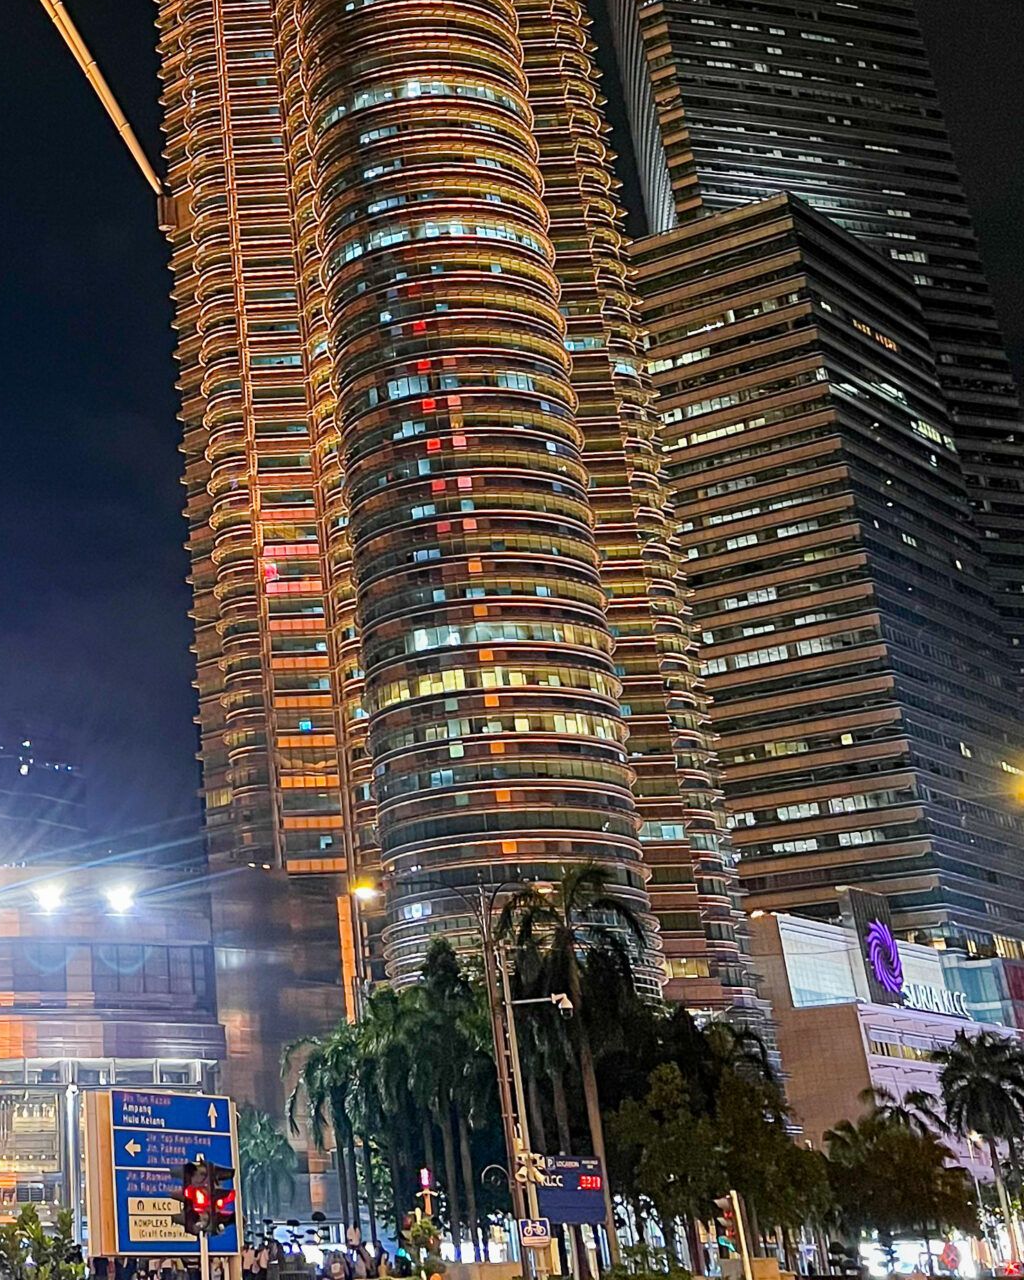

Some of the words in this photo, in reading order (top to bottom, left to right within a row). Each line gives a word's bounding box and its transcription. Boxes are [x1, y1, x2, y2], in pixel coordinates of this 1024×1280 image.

[903, 983, 943, 1013] SURIA
[940, 989, 971, 1017] KLCC
[123, 1103, 152, 1115] Ampang
[123, 1114, 140, 1124] Hulu
[140, 1115, 166, 1128] Kelang
[556, 1160, 580, 1168] LOCATION
[541, 1175, 564, 1187] KLCC
[152, 1201, 172, 1211] KLCC
[134, 1218, 168, 1228] KOMPLEKS
